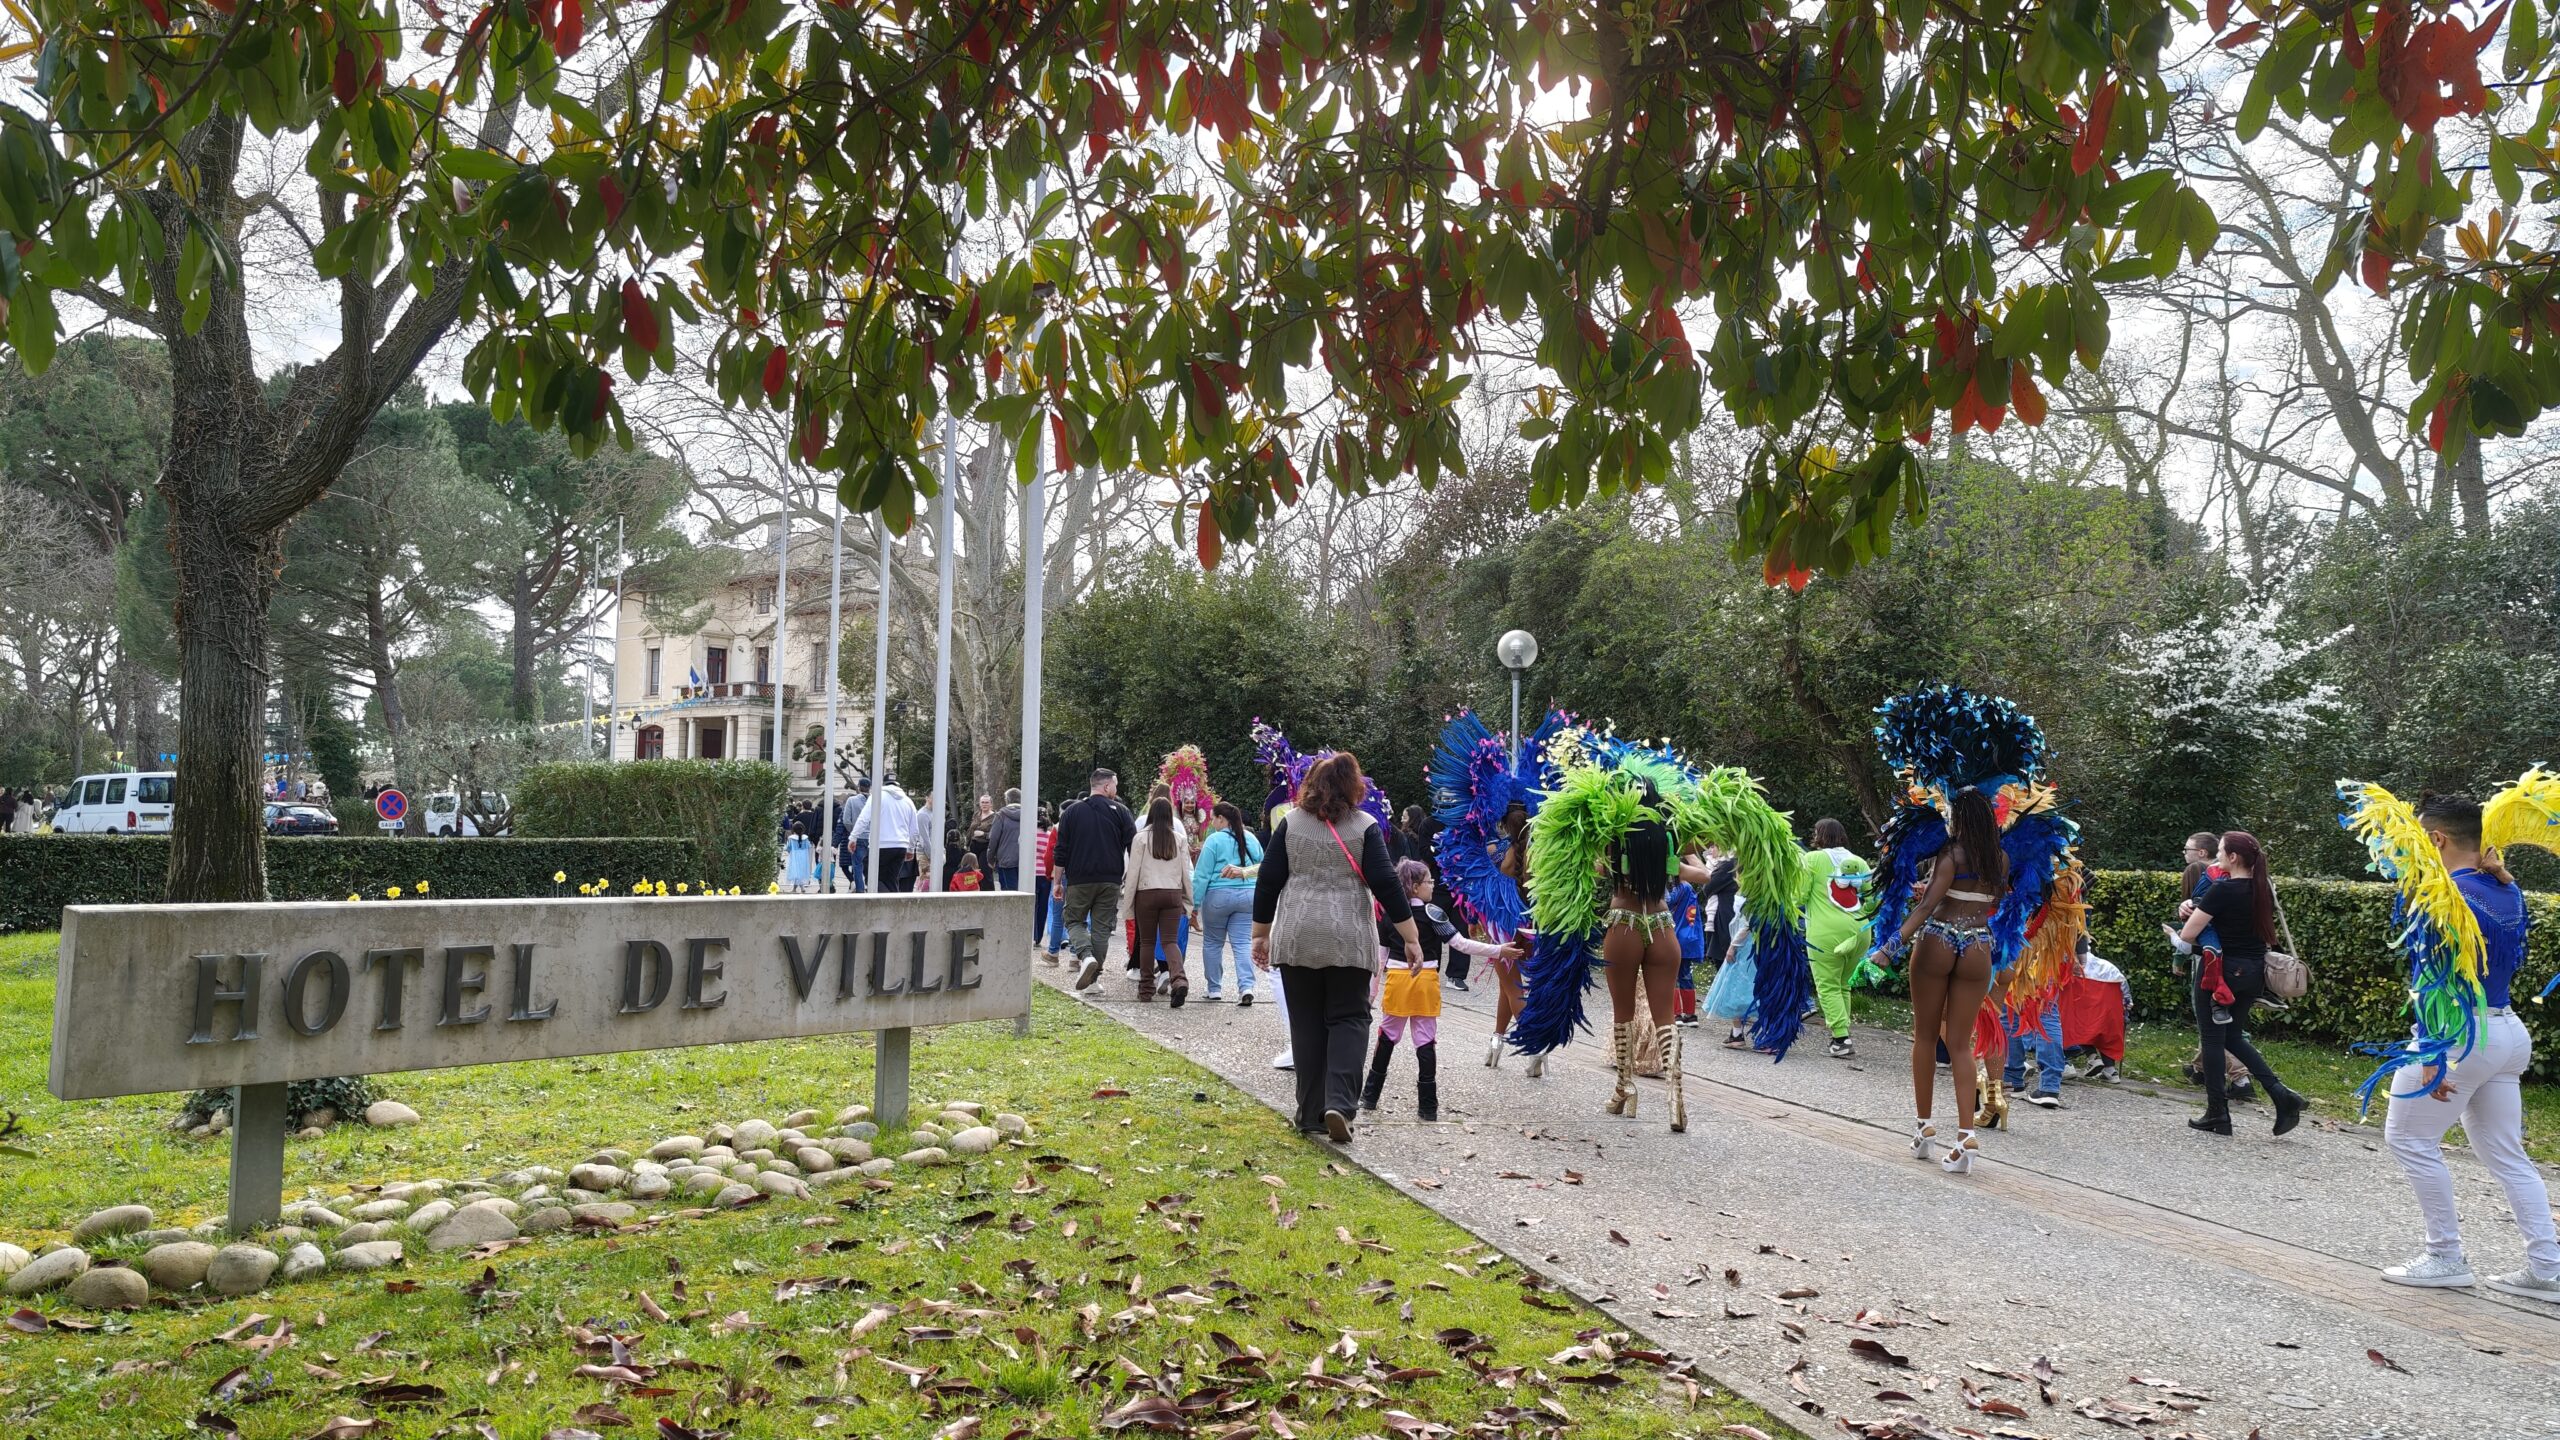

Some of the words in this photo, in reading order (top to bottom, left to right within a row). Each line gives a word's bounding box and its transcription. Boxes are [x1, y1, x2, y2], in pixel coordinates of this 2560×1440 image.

[186, 943, 558, 1045] HOTEL
[617, 937, 731, 1014] DE
[779, 927, 985, 1002] VILLE
